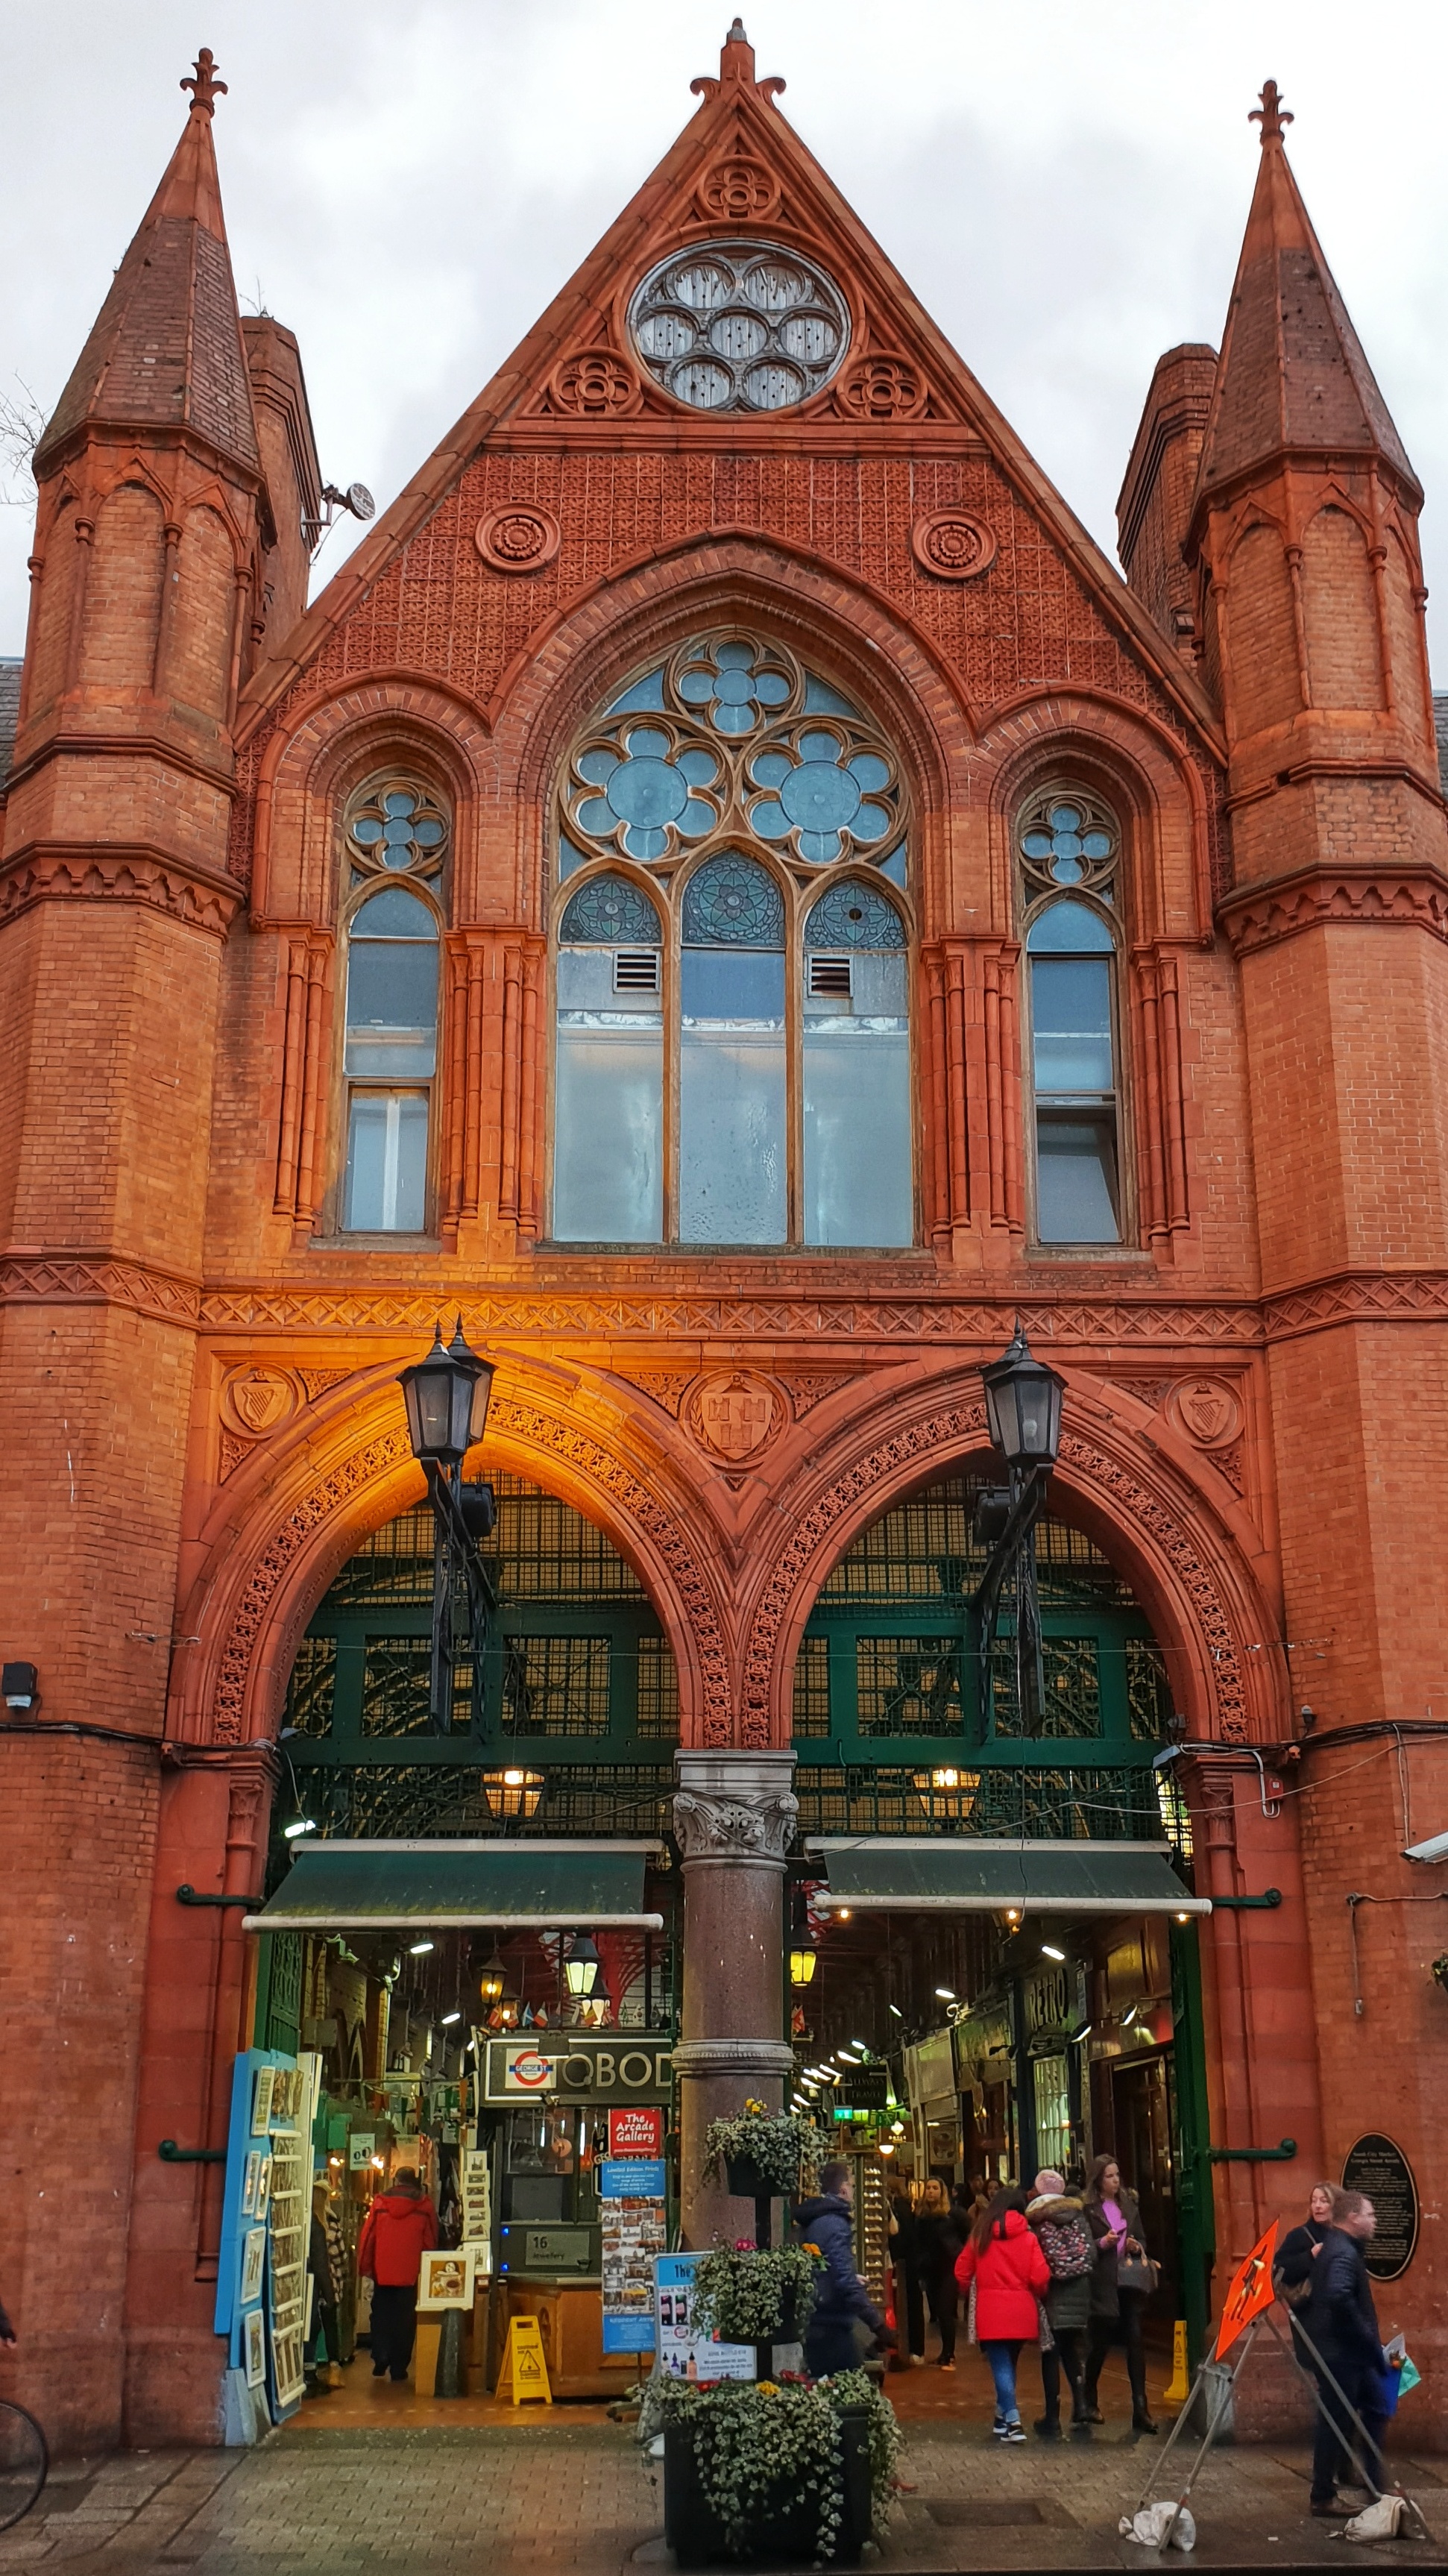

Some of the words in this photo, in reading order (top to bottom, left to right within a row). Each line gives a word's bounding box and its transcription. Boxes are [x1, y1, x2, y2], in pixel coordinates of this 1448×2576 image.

[1030, 1968, 1064, 2031] RETRO
[625, 2114, 645, 2123] The
[616, 2120, 655, 2132] Arcade
[616, 2132, 655, 2143] Gallery
[533, 2236, 548, 2249] 16
